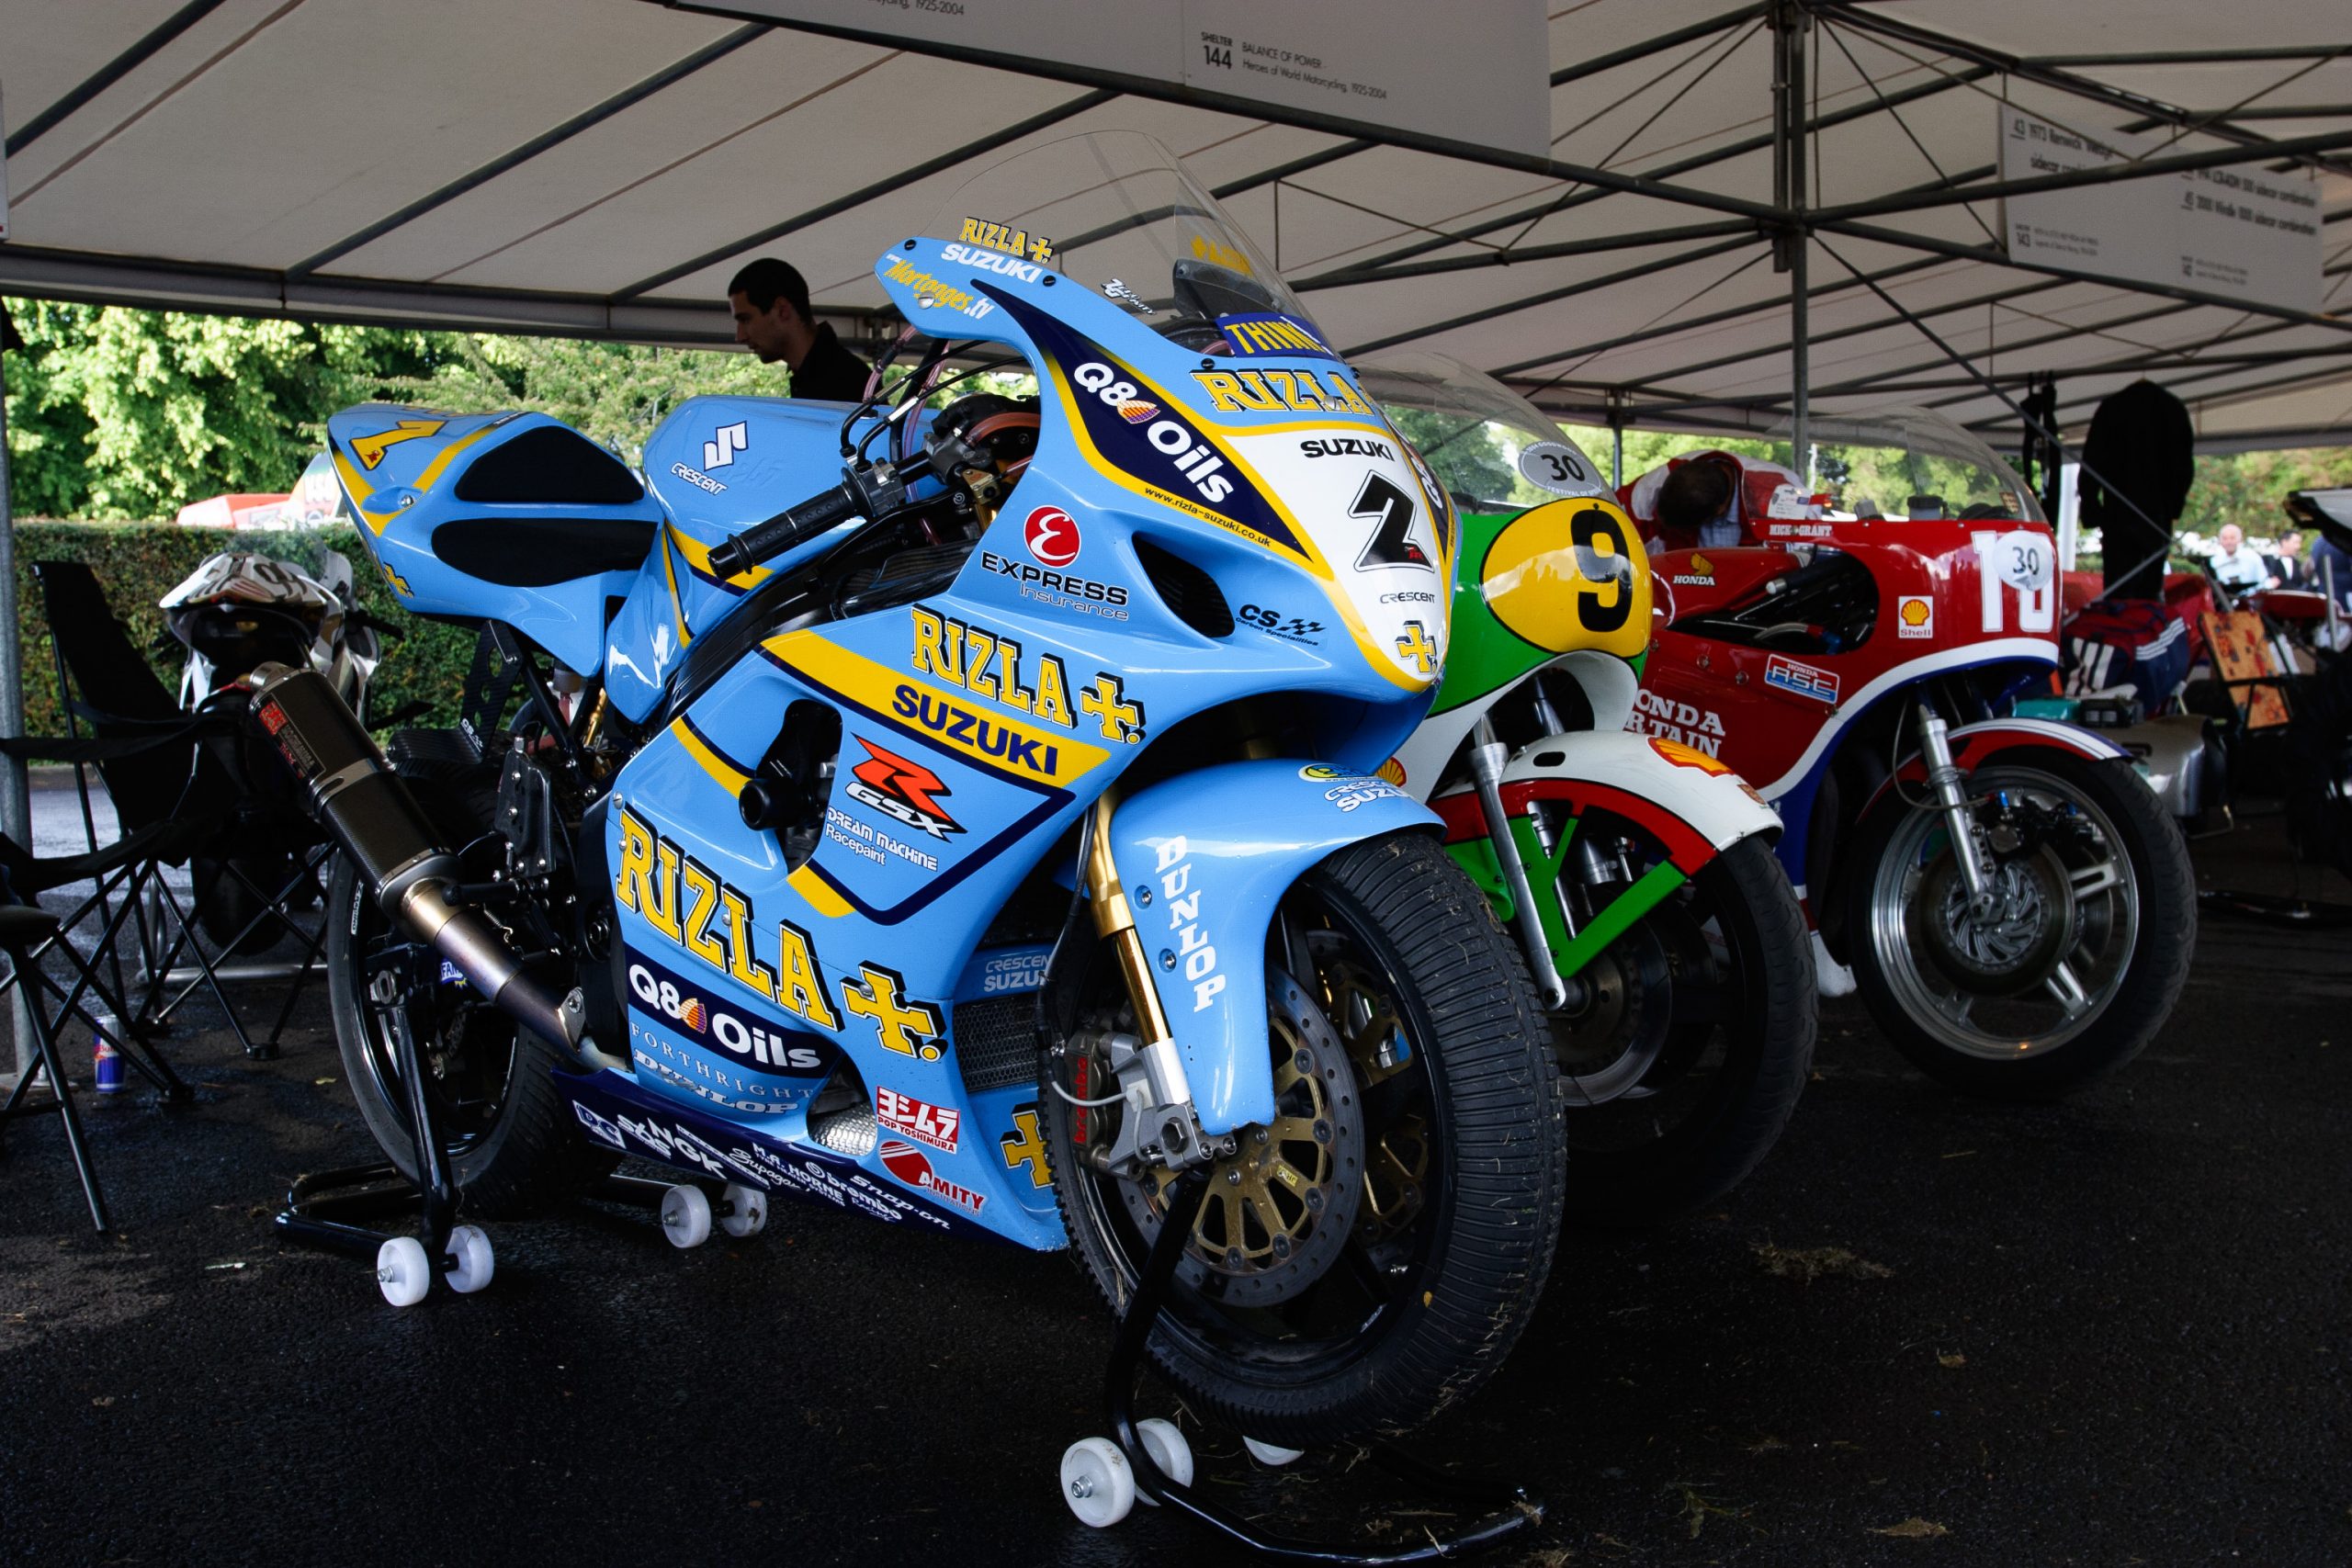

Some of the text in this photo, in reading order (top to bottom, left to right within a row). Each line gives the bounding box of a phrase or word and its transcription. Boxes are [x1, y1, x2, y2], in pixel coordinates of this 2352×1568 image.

[1201, 31, 1233, 47] SHELTER
[1204, 45, 1232, 70] 144
[1242, 42, 1322, 68] BALANCE OF POWER
[1242, 58, 1269, 74] Heroes
[1281, 69, 1301, 81] World
[941, 243, 1044, 284] SUZUKI
[1074, 362, 1235, 503] Q8 Oils
[1300, 438, 1395, 461] SUZUKI
[670, 461, 729, 496] CRESCENT
[1541, 454, 1586, 482] 30
[1145, 487, 1272, 547] www.rizla-suzuki.co.uk
[981, 550, 1129, 606] EXPRESS
[1570, 509, 1634, 633] 9
[1672, 575, 1715, 586] HONDA
[2012, 547, 2040, 576] 30
[1020, 583, 1129, 622] Insurance
[1239, 604, 1281, 628] CS
[1379, 592, 1435, 604] CRESCENT
[1900, 628, 1931, 637] Shell
[1787, 662, 1819, 678] HONDA
[892, 684, 1058, 777] SUZUKI
[1634, 688, 1726, 737] ONDA
[844, 781, 957, 842] GSX
[825, 822, 887, 866] Racepaint
[827, 807, 939, 872] DREAM MACHINE
[1155, 835, 1227, 1013] DUNLOP
[983, 969, 1045, 993] SUZU
[985, 954, 1052, 974] CRESCEN
[628, 964, 821, 1068] Q8 Oils
[630, 1021, 815, 1099] FORTHRIGHT
[634, 1048, 798, 1114] DUNLOP
[877, 1116, 956, 1153] POP YOSHIMURA
[878, 1088, 959, 1142] ヨシムラ
[647, 1117, 728, 1179] NGK
[788, 1163, 844, 1201] HORNE
[827, 1171, 902, 1220] brembo
[919, 1170, 984, 1210] AMITY
[850, 1175, 951, 1230] Snap-on
